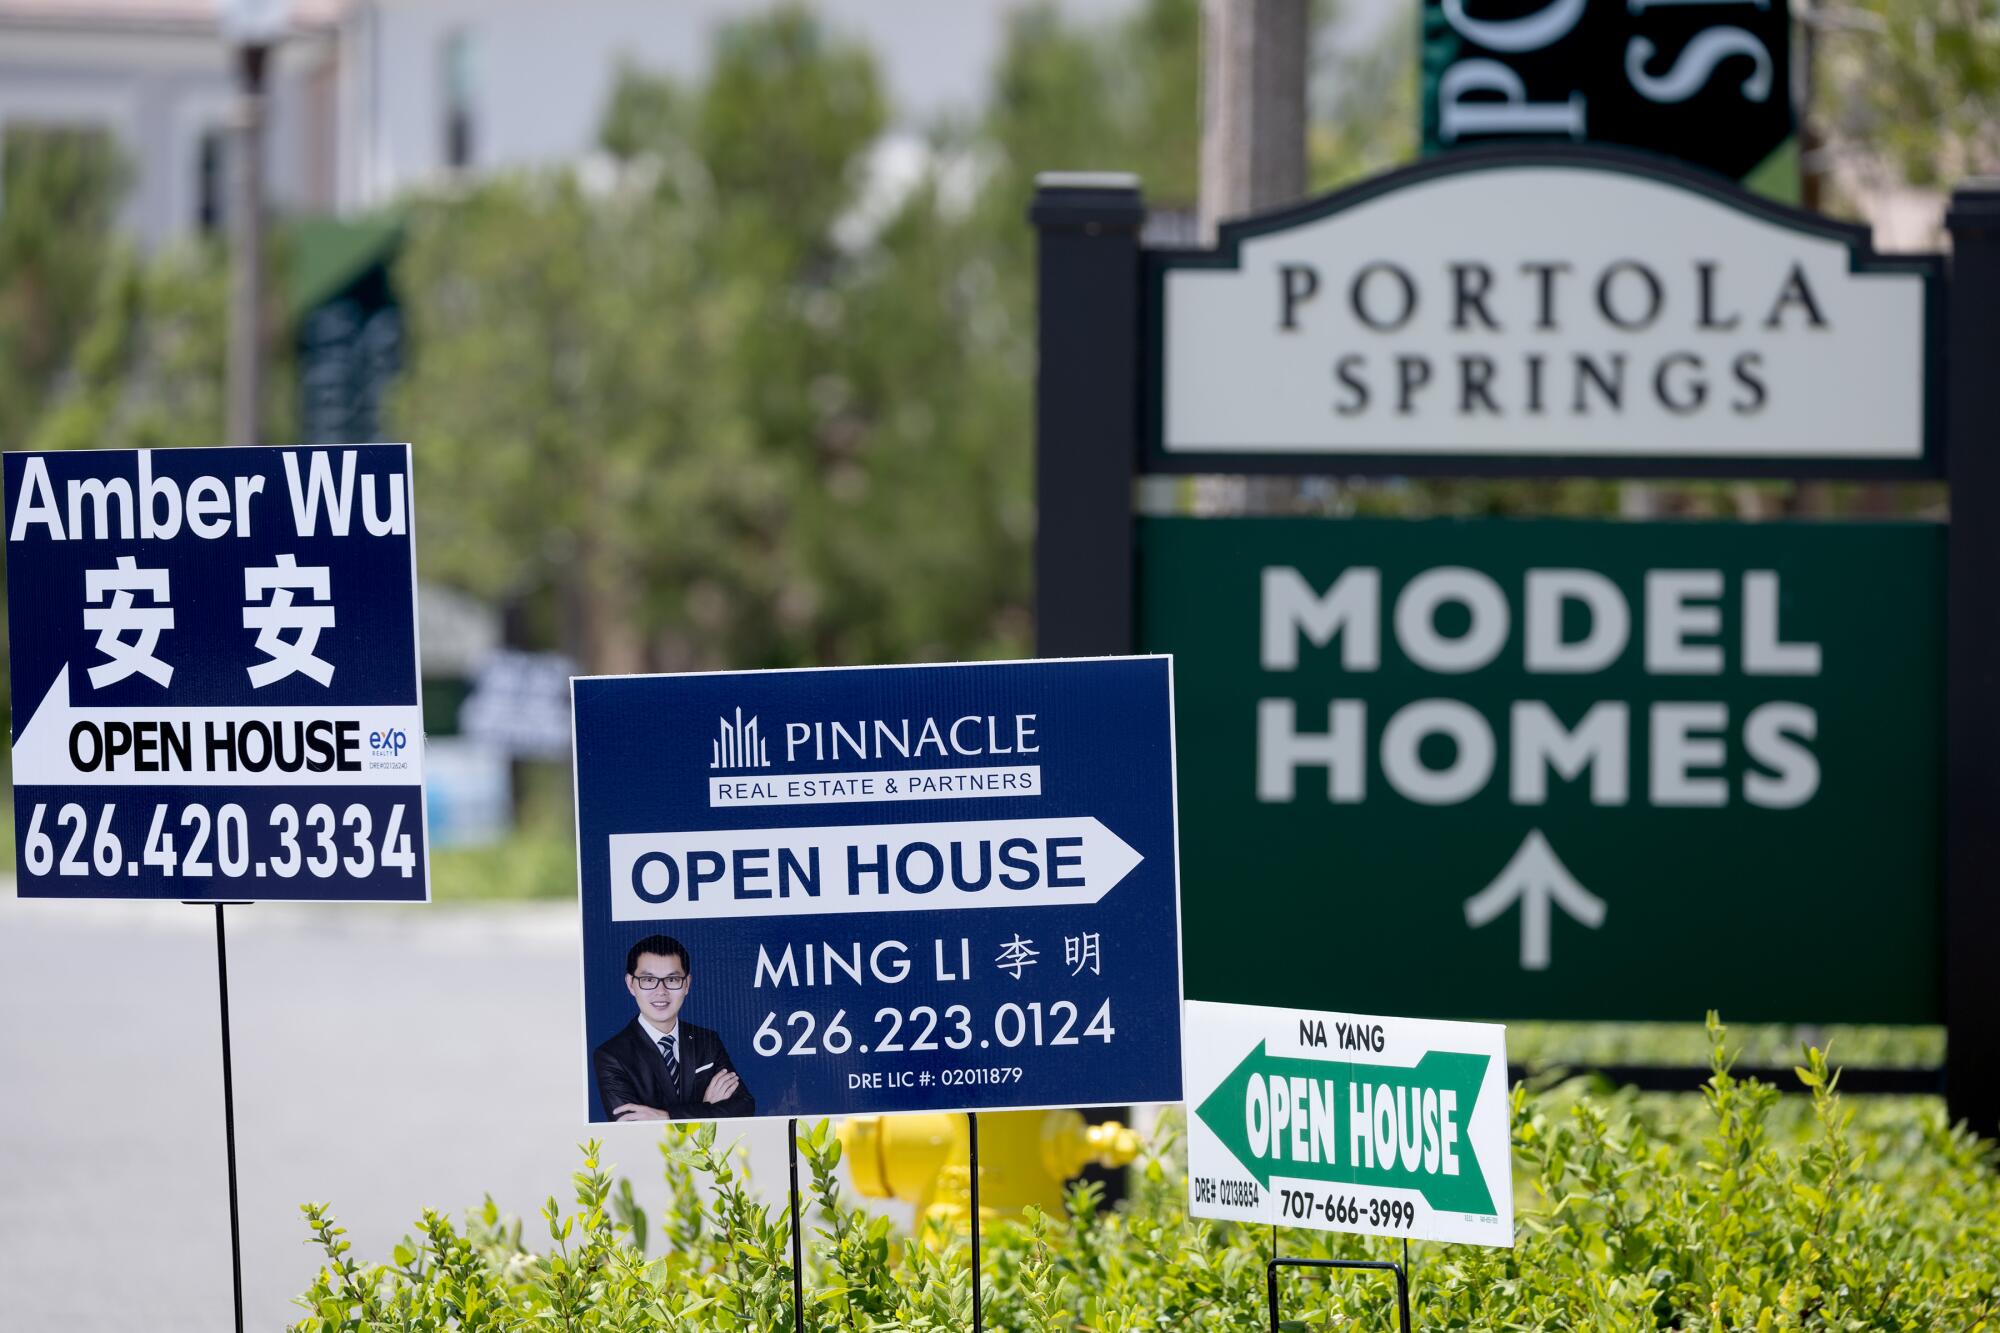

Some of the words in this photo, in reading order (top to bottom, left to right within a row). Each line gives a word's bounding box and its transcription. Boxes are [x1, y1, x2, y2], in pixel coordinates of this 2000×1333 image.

[1276, 260, 1830, 333] PORTOLA
[1335, 352, 1770, 415] SPRINGS
[10, 449, 266, 541] Amber
[282, 450, 407, 537] Wu
[1260, 565, 1822, 676] MODEL
[68, 720, 191, 773] OPEN
[205, 720, 362, 773] HOUSE
[786, 714, 1040, 762] PINNACLE
[1256, 697, 1822, 809] HOMES
[719, 782, 778, 800] REAL
[788, 778, 875, 798] ESTATE
[885, 777, 899, 795] &
[909, 772, 1033, 793] PARTNERS
[24, 803, 415, 879] 626.420.3334
[631, 846, 820, 904] OPEN
[847, 836, 1086, 897] HOUSE
[753, 940, 911, 988] MING
[935, 938, 971, 982] LI
[752, 997, 1115, 1057] 626.223.0124
[1300, 1019, 1327, 1048] NA
[1335, 1021, 1385, 1053] YANG
[848, 1073, 882, 1089] DRE
[888, 1071, 914, 1088] LIC
[919, 1071, 936, 1087] #:
[941, 1067, 1023, 1085] 02011879
[1245, 1072, 1335, 1165] OPEN
[1349, 1081, 1460, 1176] HOUSE
[1195, 1177, 1216, 1204] DRE#
[1220, 1179, 1259, 1208] 02138854
[1281, 1189, 1414, 1229] 707-666-3999
